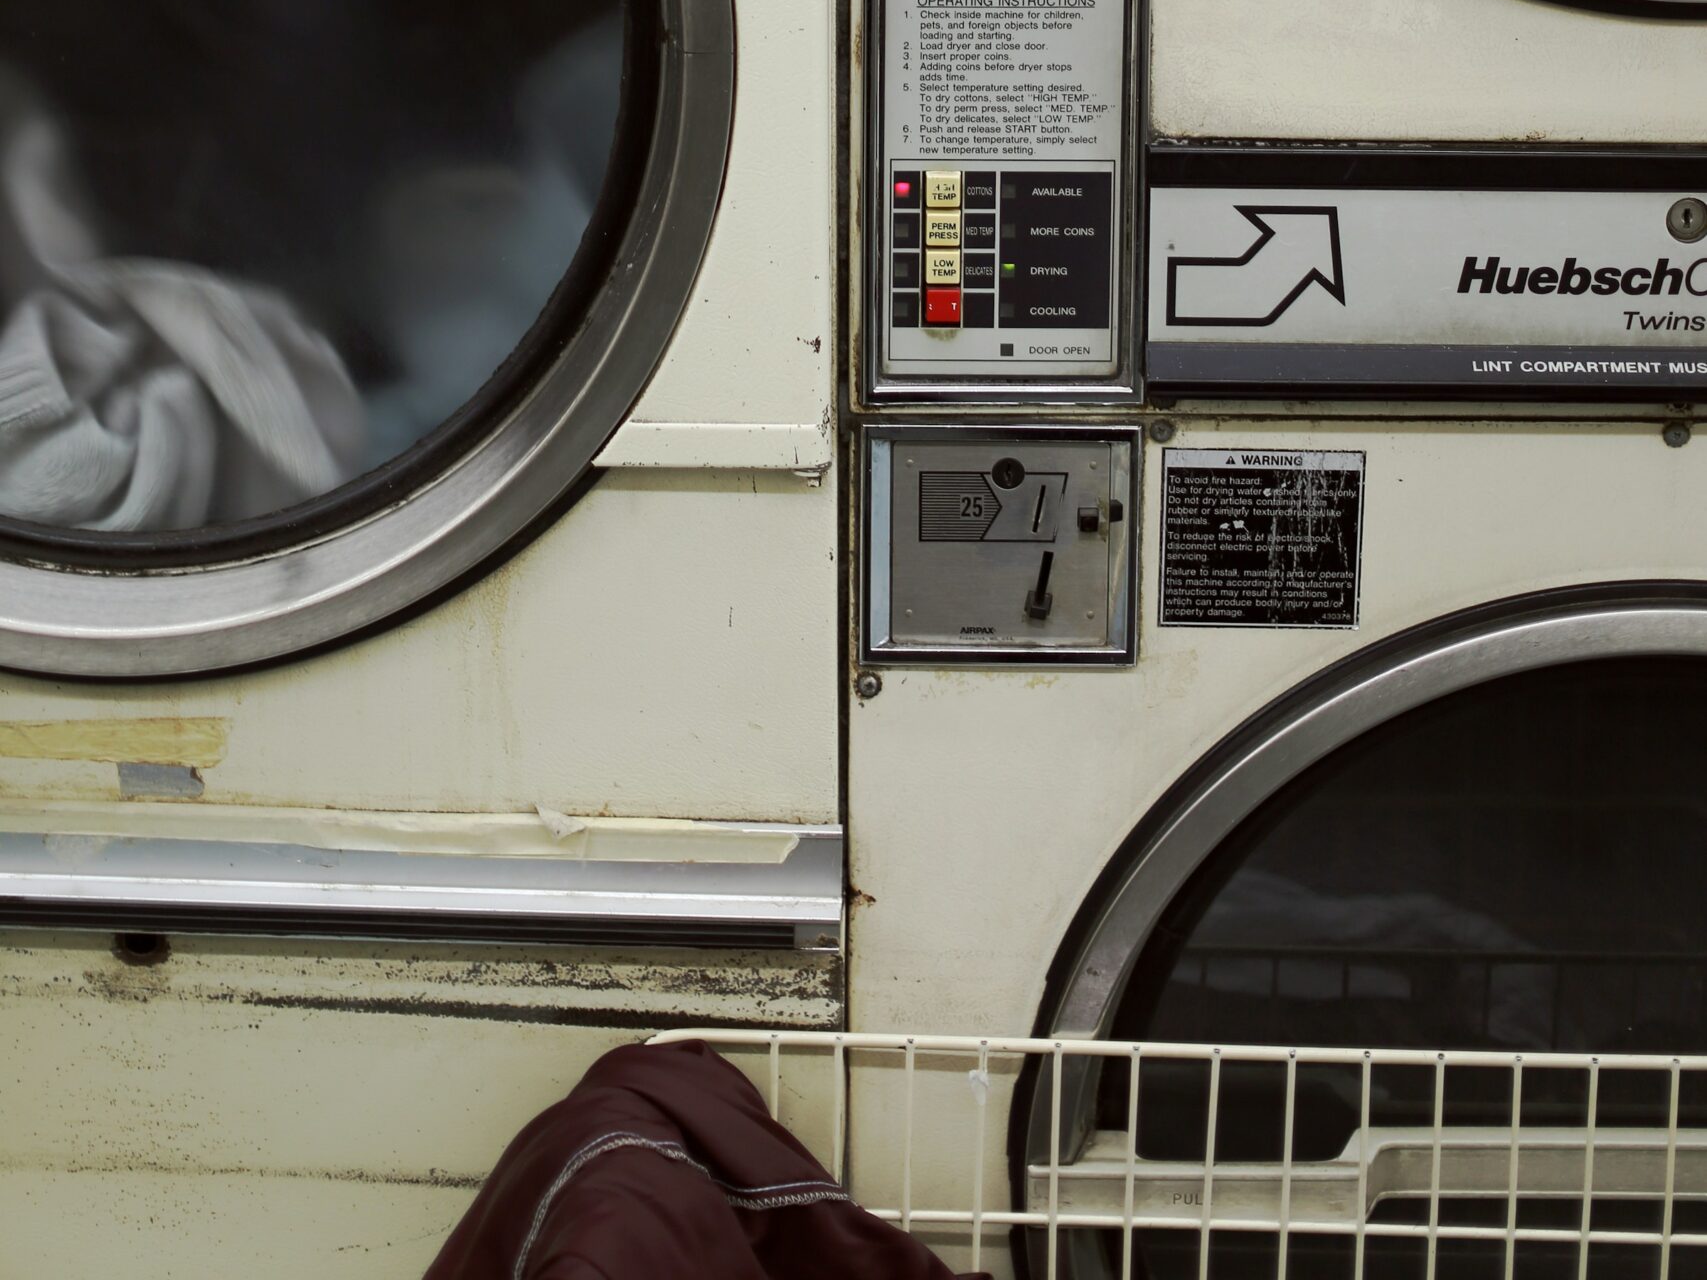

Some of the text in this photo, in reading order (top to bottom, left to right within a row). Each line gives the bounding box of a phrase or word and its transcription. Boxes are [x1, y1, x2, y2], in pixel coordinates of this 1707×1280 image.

[920, 11, 950, 19] Check
[954, 11, 981, 19] inside
[985, 11, 1024, 19] machine
[1028, 11, 1040, 19] for
[1044, 11, 1084, 20] children,
[920, 21, 1072, 31] pets, and foreign objects before
[920, 32, 1015, 41] loading and starting.
[920, 42, 943, 50] Load
[947, 42, 971, 51] dryer
[975, 42, 992, 50] and
[996, 42, 1020, 50] close
[1025, 42, 1048, 50] door.
[984, 53, 1011, 61] coins.
[920, 63, 952, 72] Adding
[956, 63, 980, 71] coins
[985, 63, 1014, 71] before
[1018, 63, 1042, 72] dryer
[1047, 63, 1072, 72] stops
[920, 73, 968, 81] adds time.
[920, 84, 949, 92] Select
[953, 84, 1009, 92] temperature
[1013, 84, 1043, 93] setting
[1048, 84, 1084, 92] desired.
[920, 94, 931, 102] To
[935, 94, 950, 103] dry
[996, 94, 1024, 102] select
[935, 105, 950, 113] dry
[920, 115, 931, 123] To
[935, 115, 950, 124] dry
[1003, 115, 1031, 123] select
[920, 136, 931, 144] To
[935, 136, 969, 145] change
[973, 136, 1032, 145] temperature,
[1036, 136, 1064, 145] simply
[1069, 136, 1097, 144] select
[943, 146, 998, 155] temperature
[1002, 146, 1036, 155] setting.
[967, 186, 992, 196] COTTONS
[1032, 188, 1082, 196] AVAILABLE
[966, 227, 993, 235] MED TEMP
[932, 269, 956, 277] TEMP
[966, 267, 993, 275] DELICATES
[1031, 267, 1068, 275] DRYING
[1030, 307, 1076, 315] COOLING
[1624, 312, 1706, 331] Twins
[1472, 361, 1513, 373] LINT
[1520, 361, 1661, 373] COMPARTMENT
[1241, 455, 1303, 466] WARNING
[1169, 475, 1181, 483] To
[1184, 476, 1208, 484] avoid
[1212, 476, 1226, 484] fire
[1190, 486, 1202, 494] for
[1206, 487, 1233, 496] drying
[1168, 496, 1181, 504] Do
[1202, 497, 1217, 506] dry
[961, 497, 983, 517] 25
[1186, 578, 1223, 586] machine
[1215, 598, 1252, 607] produce
[1165, 608, 1204, 617] property
[1173, 1193, 1213, 1205] PUL
